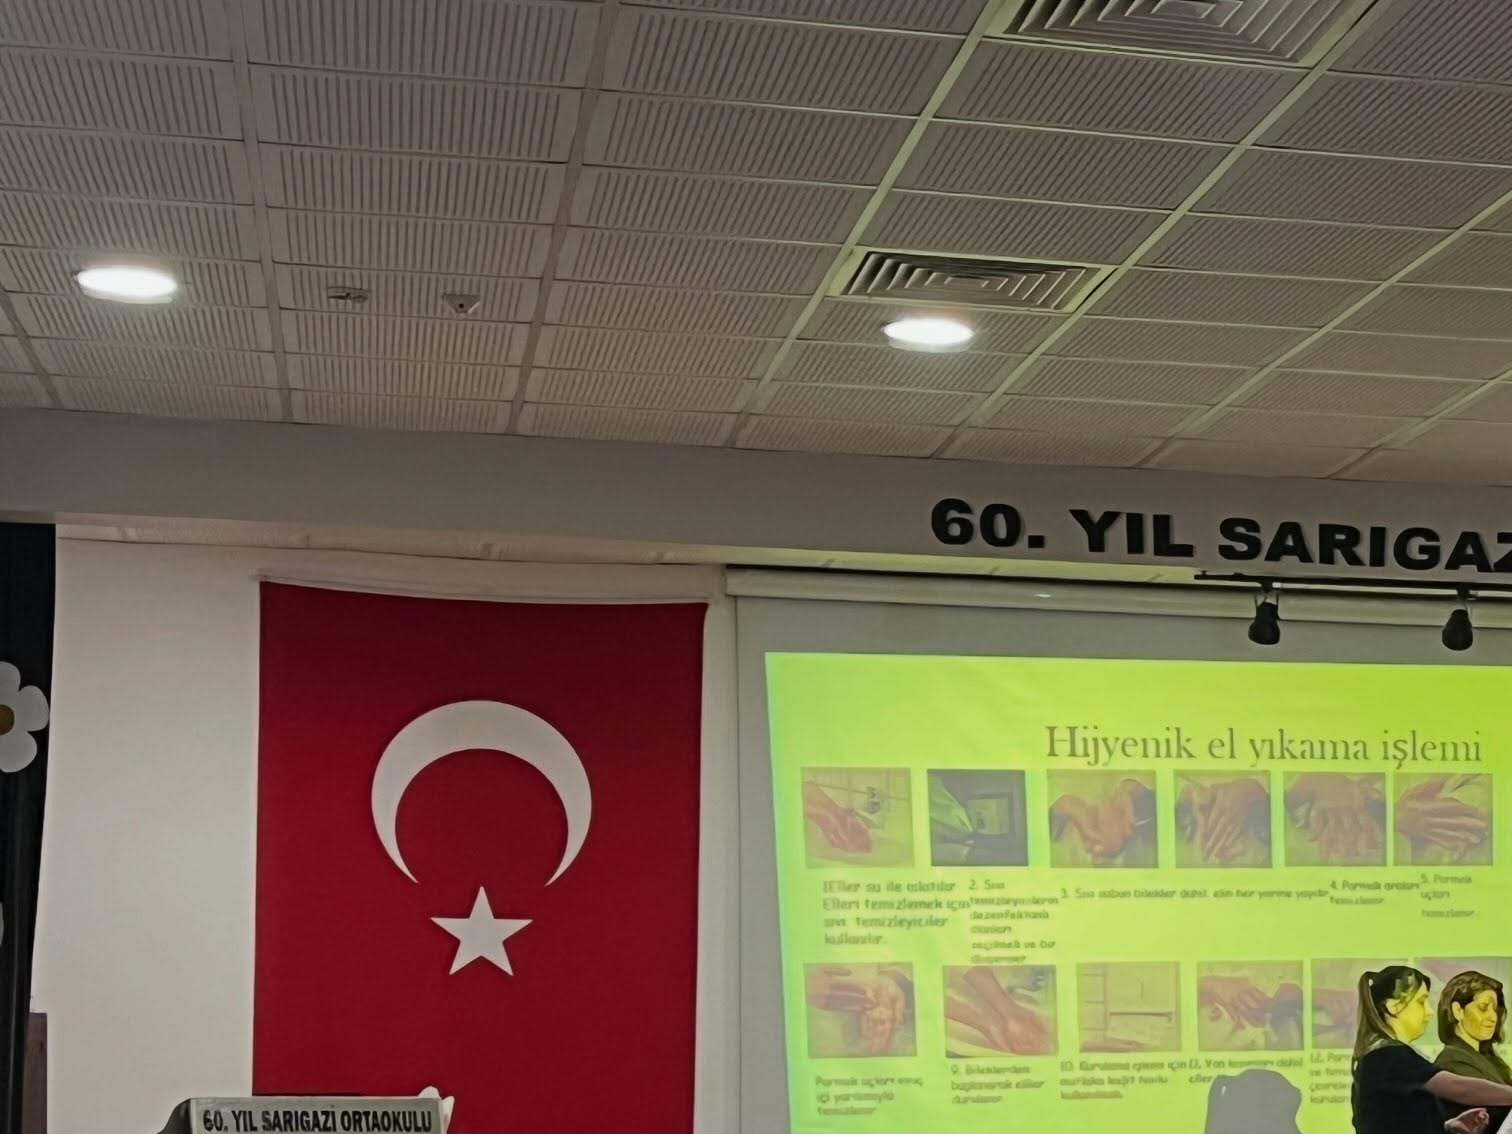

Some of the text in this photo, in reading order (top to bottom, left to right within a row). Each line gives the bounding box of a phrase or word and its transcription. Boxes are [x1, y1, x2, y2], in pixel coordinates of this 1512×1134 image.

[931, 498, 1046, 548] 60.
[1069, 509, 1194, 557] YIL
[1046, 725, 1482, 769] Hijyenik el yıkama işlemi
[203, 1109, 228, 1132] 60.
[231, 1110, 258, 1132] YIL
[340, 1110, 432, 1132] ORTAOKULU
